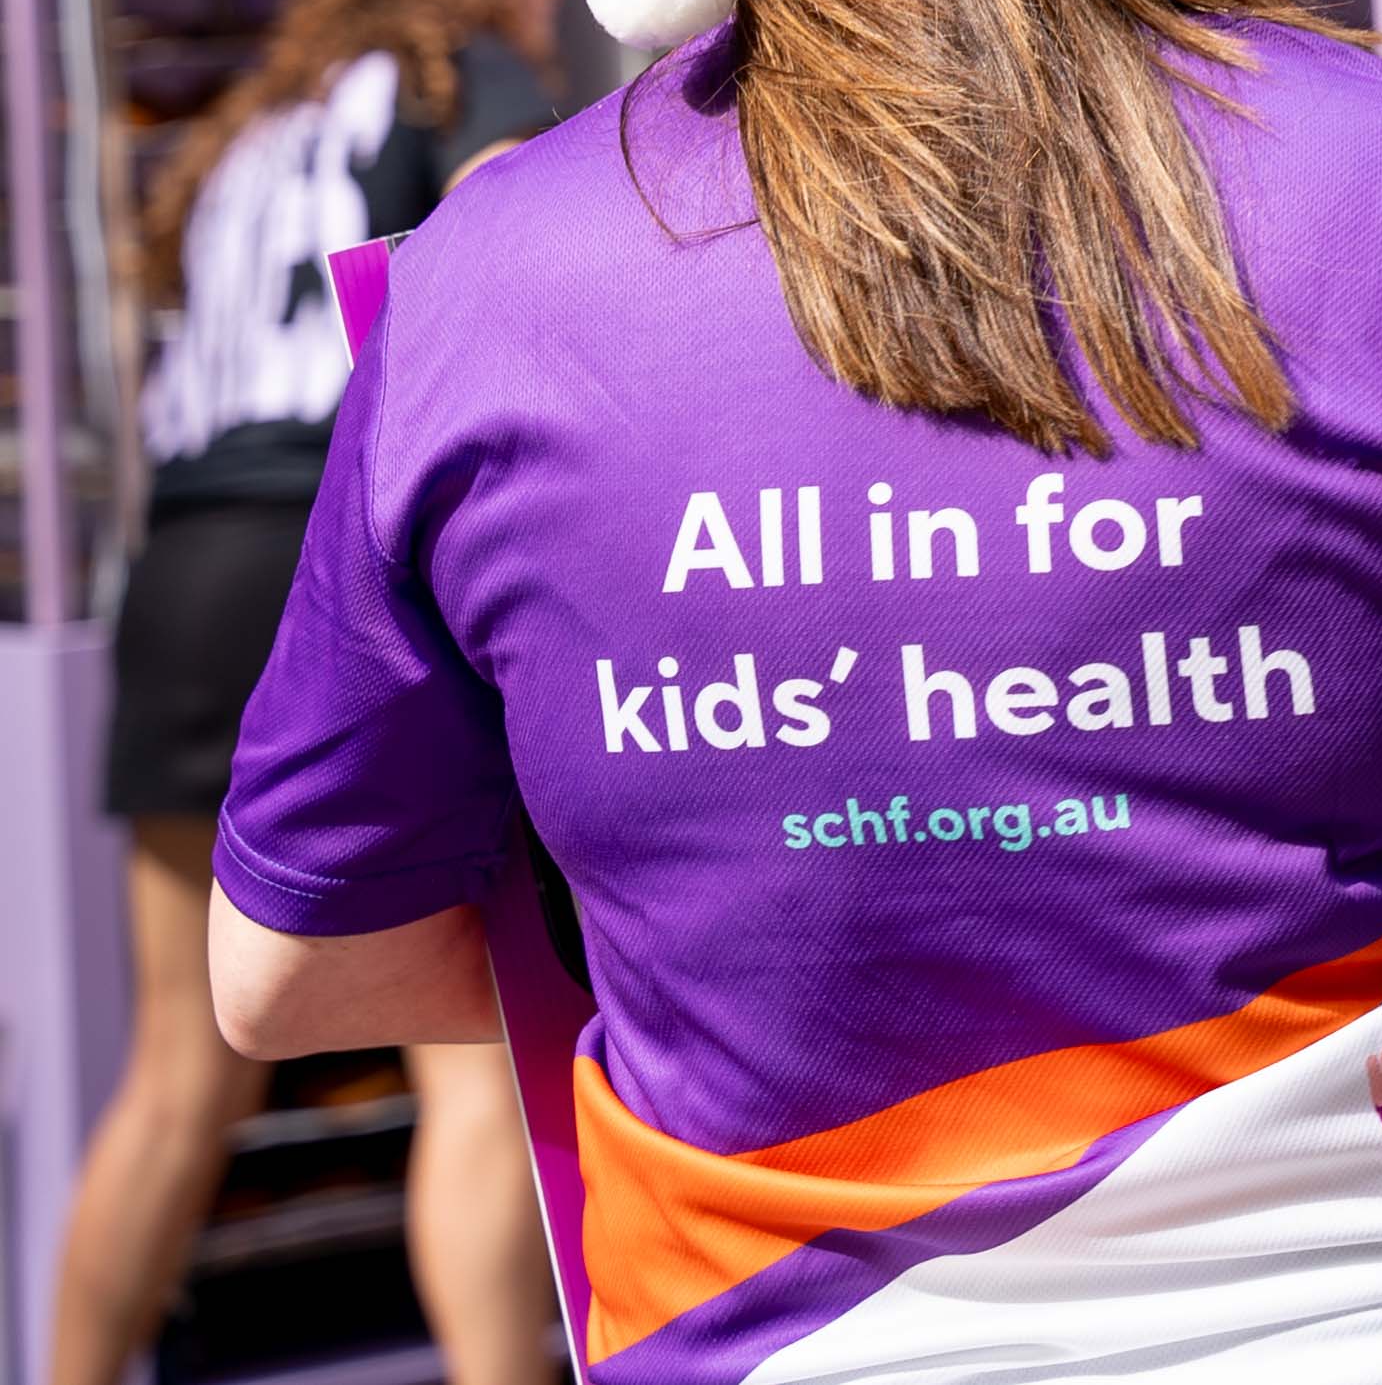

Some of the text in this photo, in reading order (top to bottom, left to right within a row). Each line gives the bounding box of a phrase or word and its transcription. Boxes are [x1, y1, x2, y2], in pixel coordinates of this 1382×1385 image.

[661, 471, 1204, 594] All in for
[595, 625, 1316, 754] kids' health
[782, 792, 1133, 853] schf.org.au
